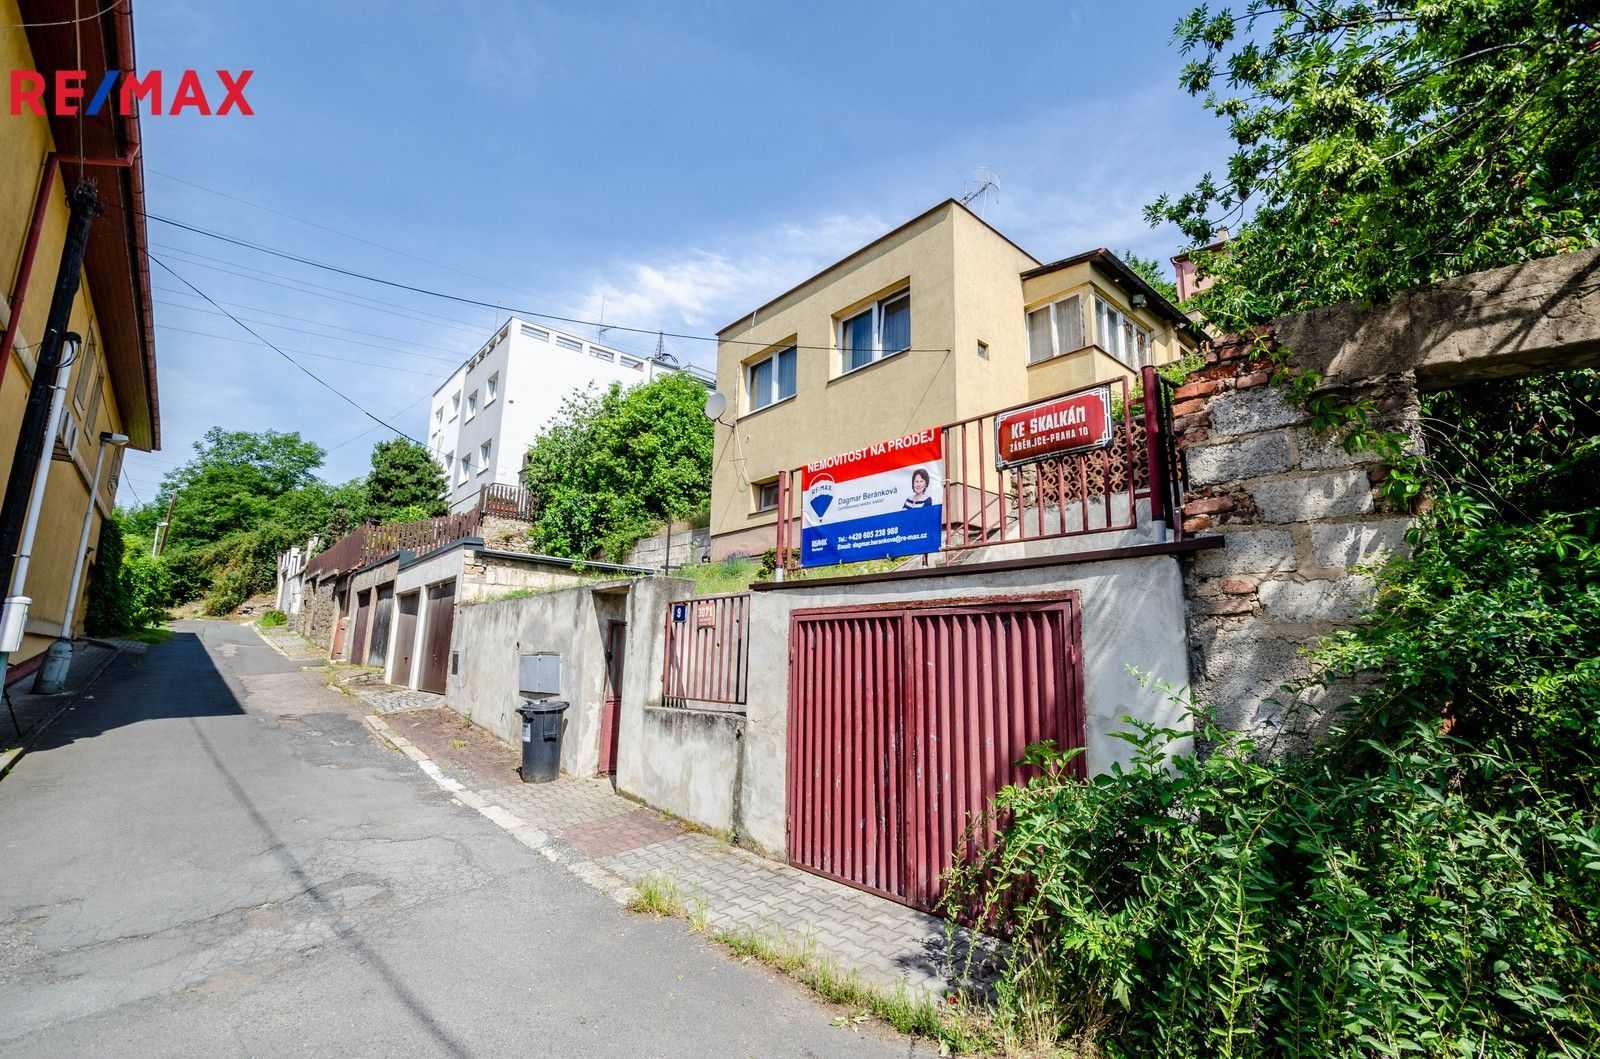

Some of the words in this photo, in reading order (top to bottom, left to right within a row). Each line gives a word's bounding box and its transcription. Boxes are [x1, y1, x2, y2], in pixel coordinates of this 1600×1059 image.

[1011, 421, 1025, 439] KE
[1030, 405, 1086, 434] SKALKÁM
[1079, 426, 1089, 436] 10
[807, 447, 869, 473] NEMOVITOST
[870, 443, 886, 456] NA
[887, 429, 935, 452] PRODEJ
[838, 495, 861, 505] Dagmar
[862, 486, 898, 500] Beránková
[848, 533, 862, 541] +420
[863, 531, 874, 539] 605
[874, 529, 886, 538] 238
[887, 527, 898, 535] 988
[676, 607, 681, 617] 9
